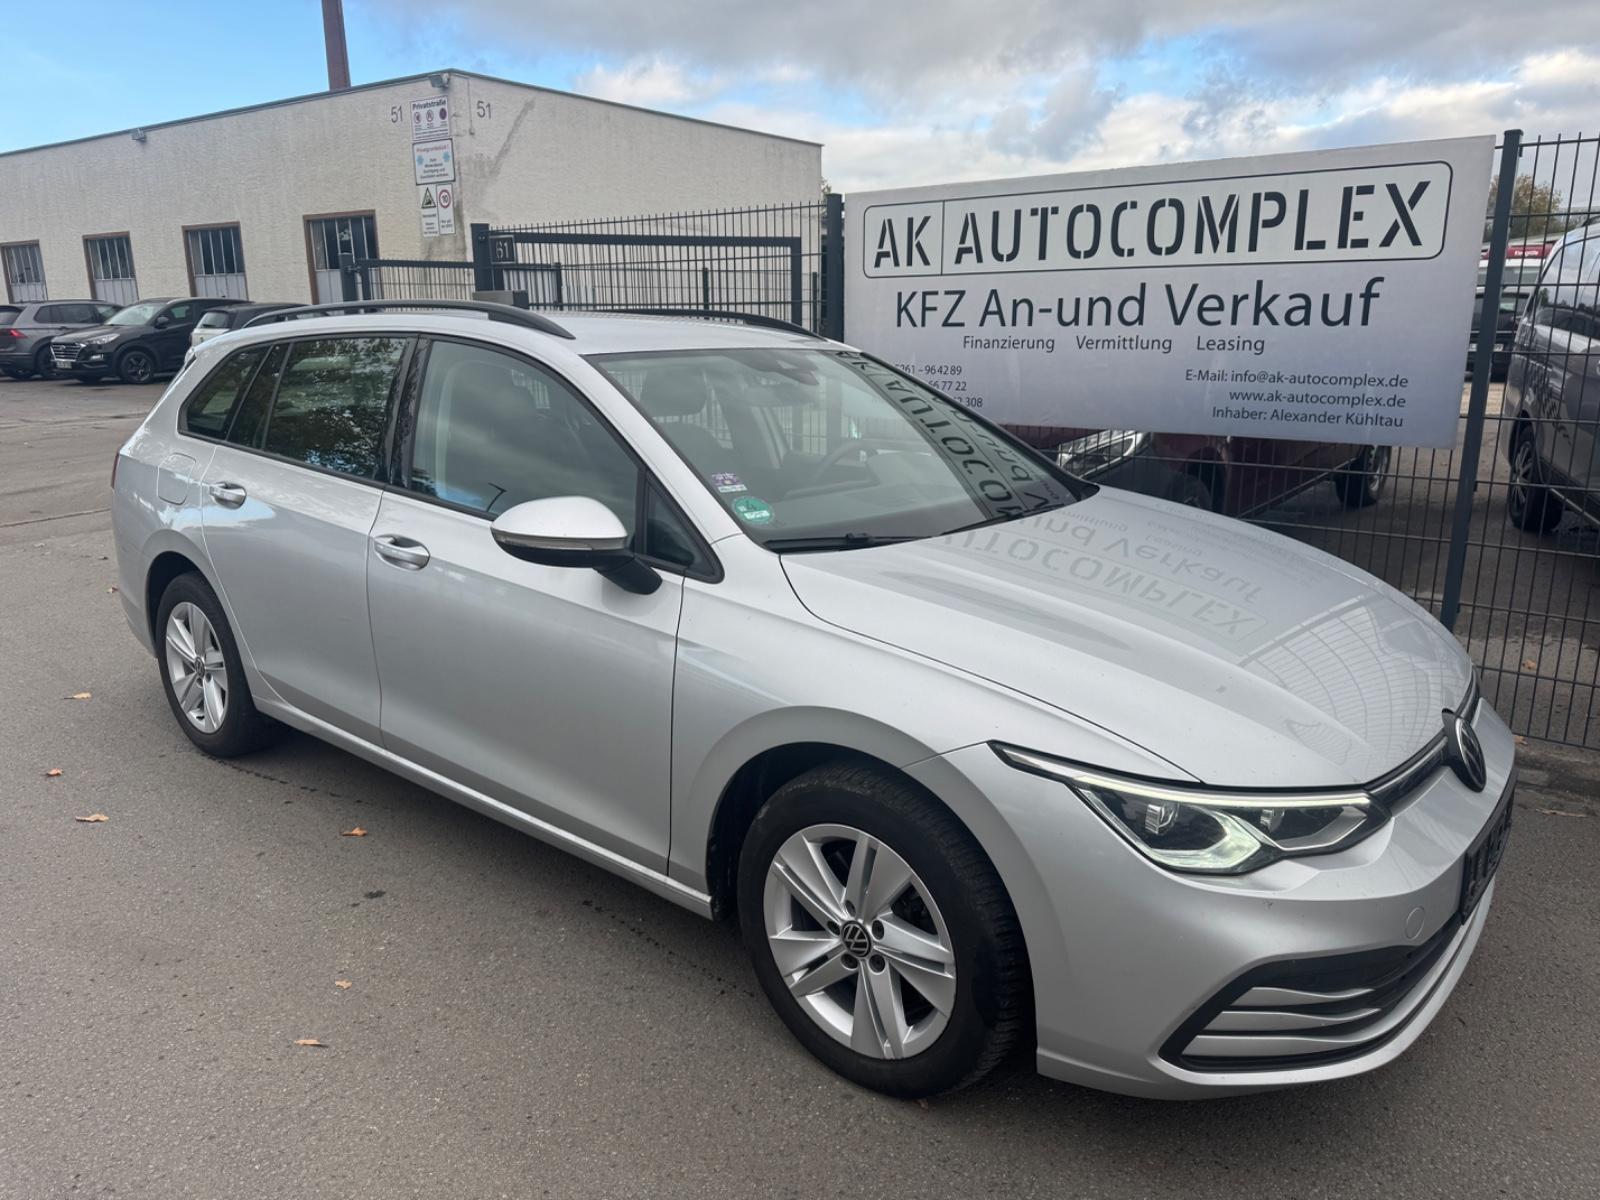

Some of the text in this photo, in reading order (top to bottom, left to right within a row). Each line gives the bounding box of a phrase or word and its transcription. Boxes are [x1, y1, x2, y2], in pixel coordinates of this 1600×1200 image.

[390, 105, 404, 123] 51
[412, 99, 447, 111] Privatstraße
[476, 101, 492, 119] 51
[873, 181, 1431, 268] AK AUTOCOMPLEX
[896, 276, 1385, 328] KFZ An-und Verkauf
[963, 335, 1265, 355] Finanzierung Vermittlung Leasing
[955, 380, 967, 392] 22
[1185, 368, 1409, 389] E-Mail: info@ak-autocomplex.de
[1228, 389, 1406, 408] www.ak-autocomplex.de
[1212, 406, 1404, 428] Inhaber: Alexander Kühltau
